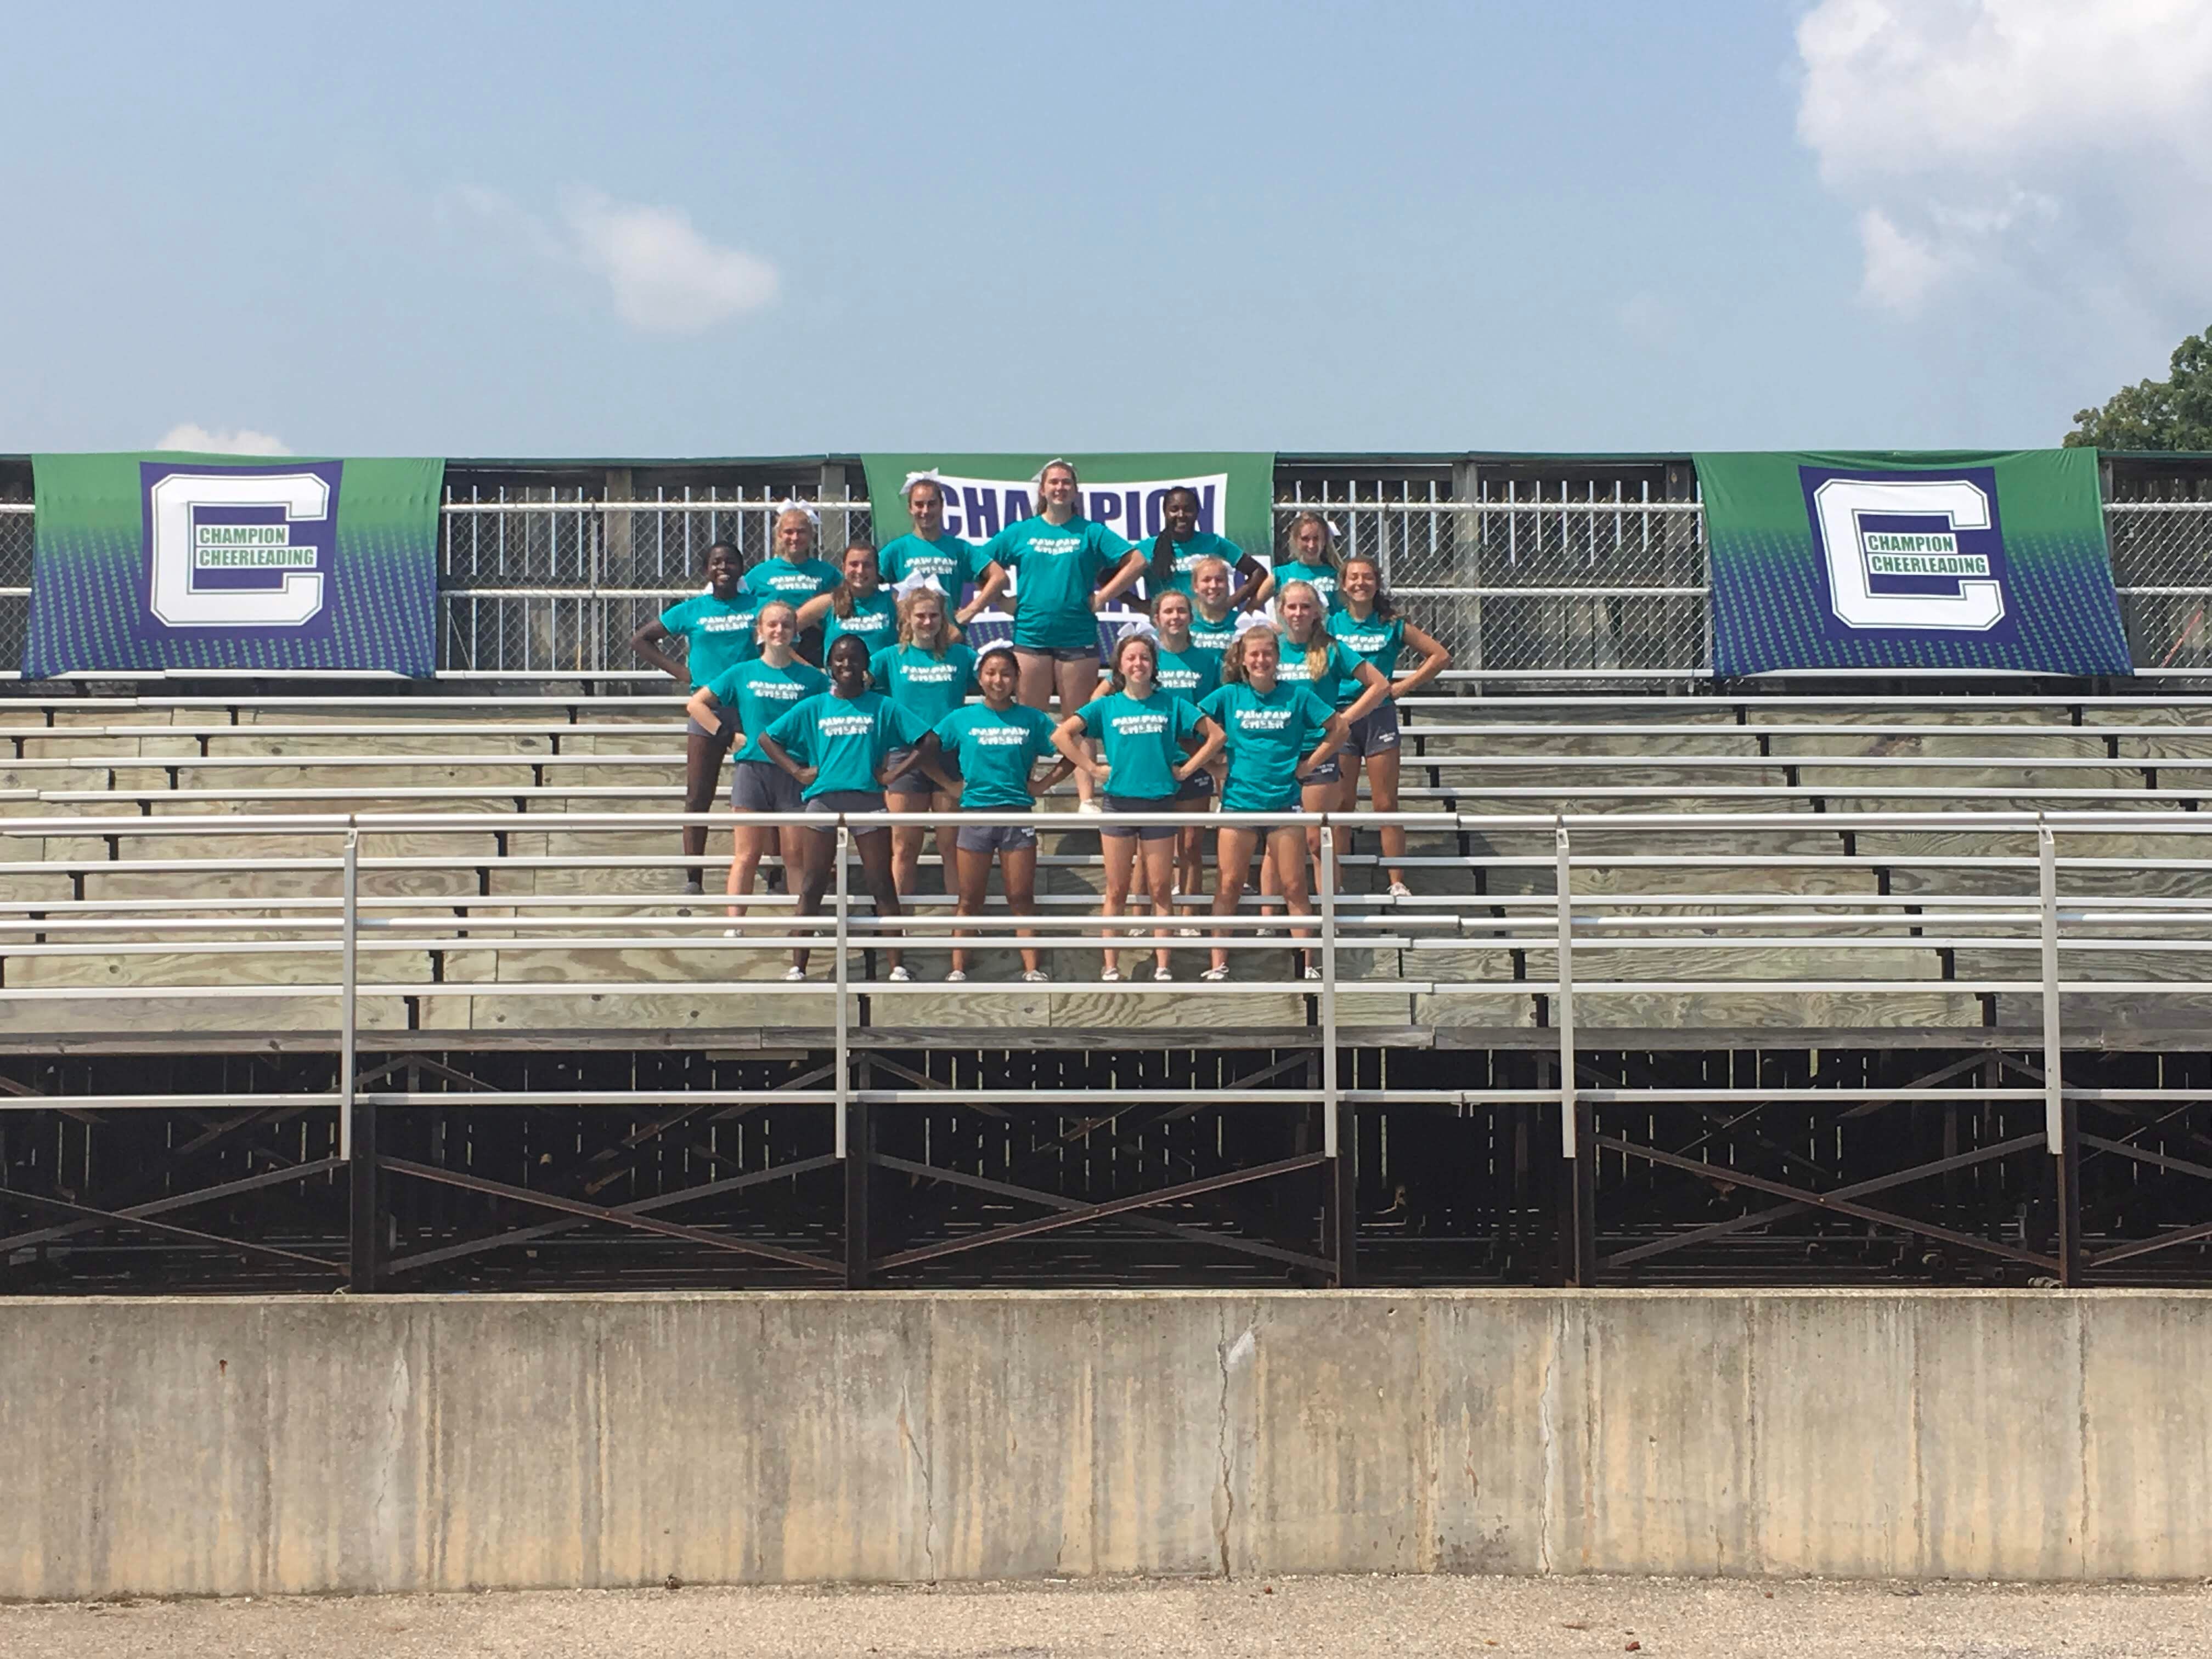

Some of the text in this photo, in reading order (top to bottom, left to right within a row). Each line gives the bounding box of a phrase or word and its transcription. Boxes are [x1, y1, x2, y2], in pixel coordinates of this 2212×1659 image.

[939, 483, 1215, 541] CHAPION
[200, 528, 286, 544] CHAMPION
[1056, 538, 1080, 546] PAW
[1867, 535, 1954, 552] CHAMPION
[199, 549, 314, 566] CHEERLEADING
[904, 557, 957, 568] PAW PAW
[1871, 556, 1986, 573] CHEERLEADING
[767, 574, 822, 585] PAW PAW
[697, 614, 754, 624] PAW PAW
[900, 664, 957, 674] PAW PAW
[1176, 670, 1203, 679] PAW
[747, 681, 776, 689] PAW
[1235, 710, 1291, 719] PAW PAW
[819, 716, 874, 729] PAW PAW
[1112, 715, 1168, 727] PAW PAW
[1002, 727, 1030, 736] PAW
